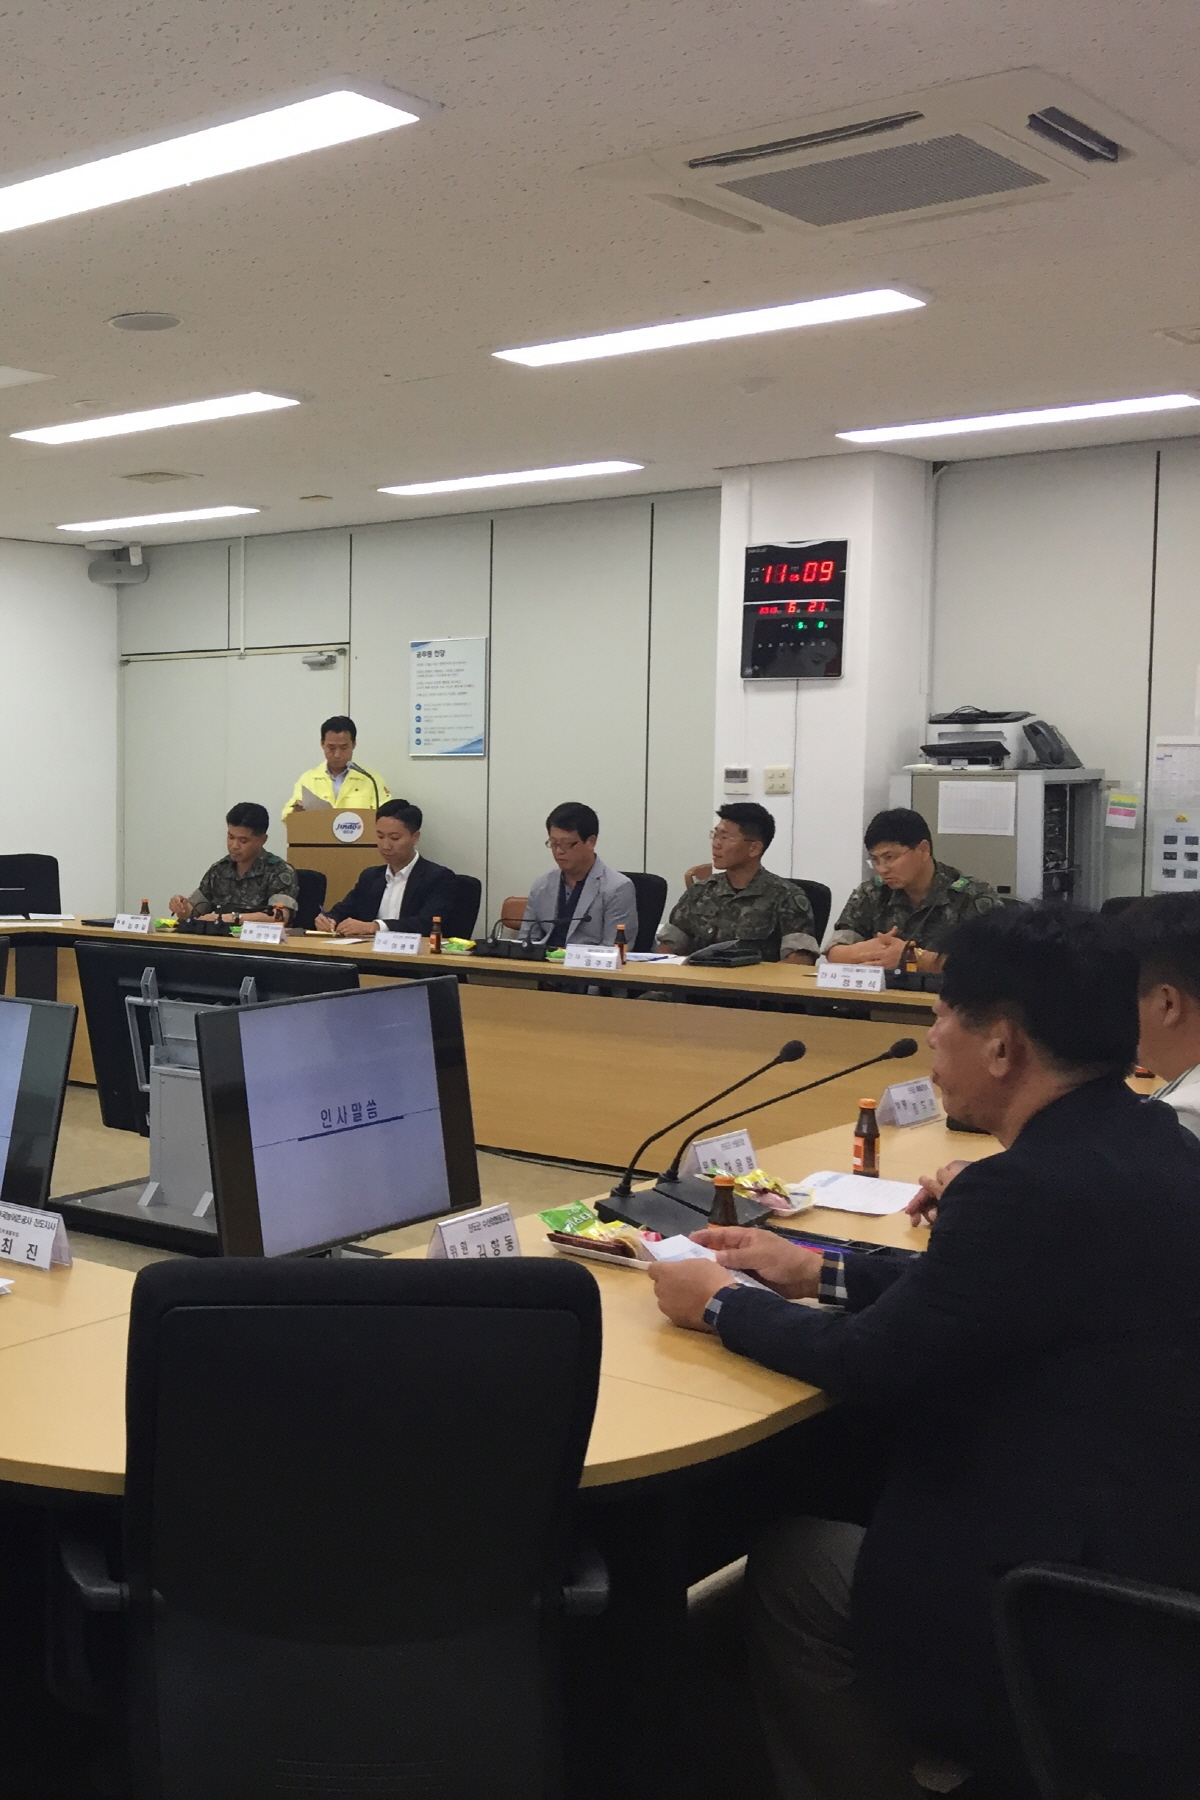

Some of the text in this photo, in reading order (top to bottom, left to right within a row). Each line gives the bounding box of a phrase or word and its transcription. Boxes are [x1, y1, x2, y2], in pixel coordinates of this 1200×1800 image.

[802, 560, 835, 584] 09
[807, 601, 826, 613] 21
[320, 1099, 378, 1129] 인사말씀
